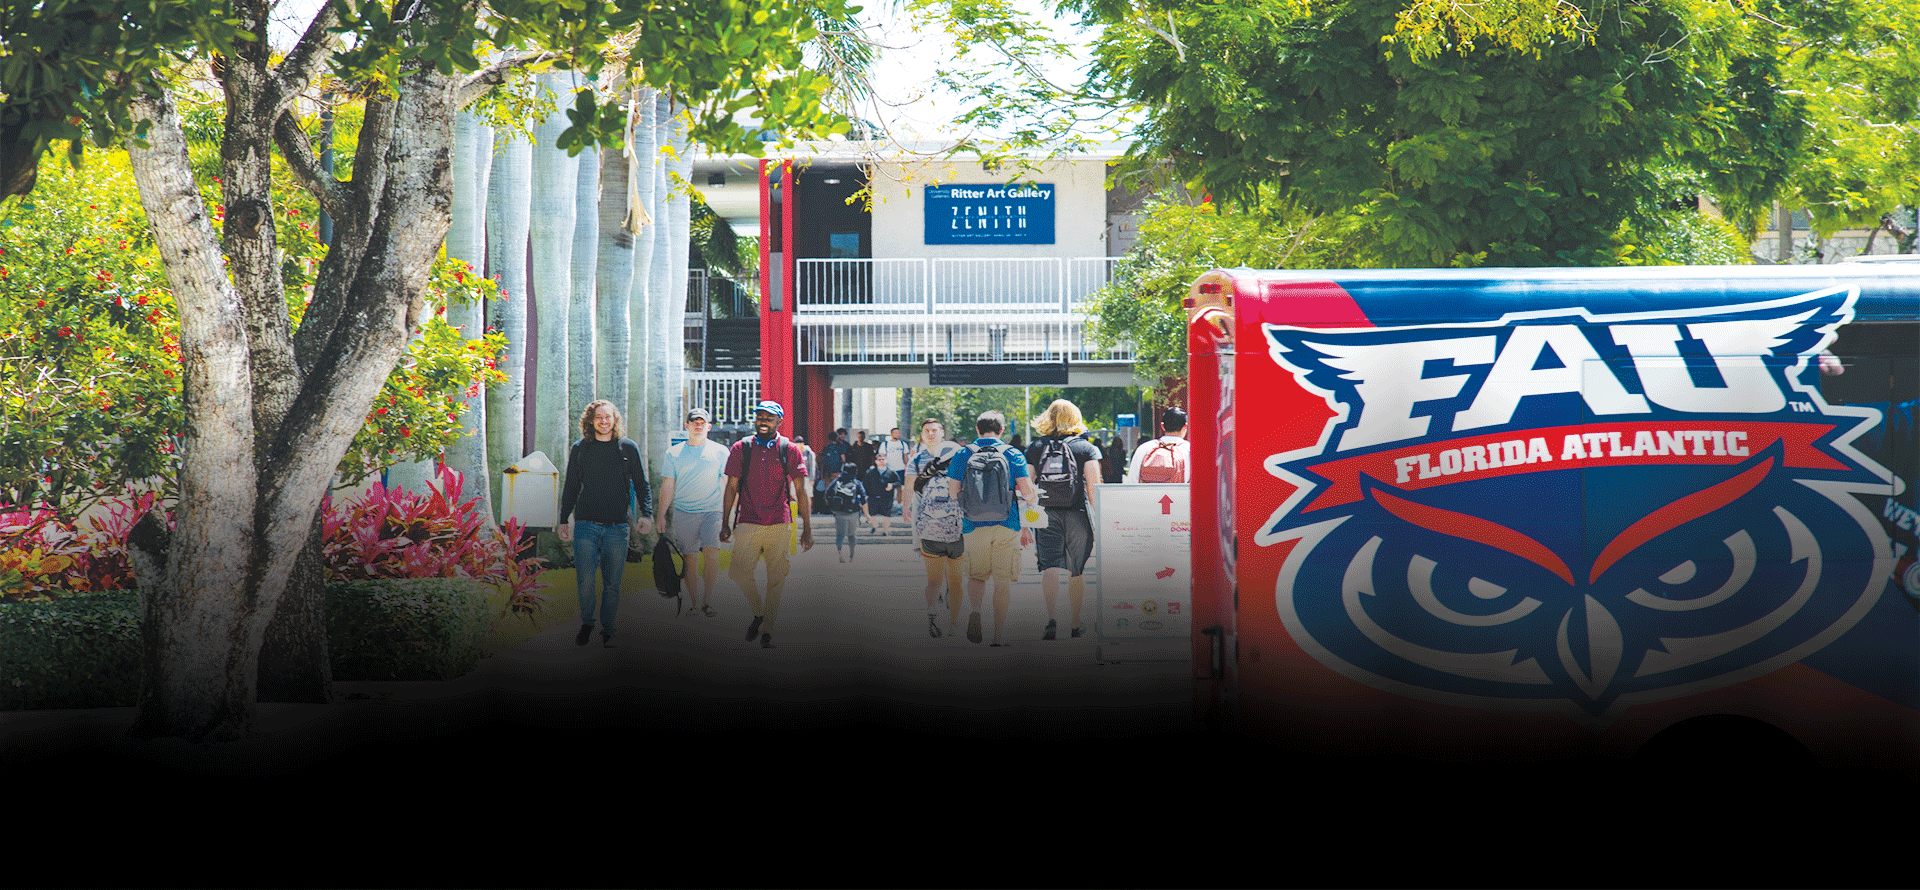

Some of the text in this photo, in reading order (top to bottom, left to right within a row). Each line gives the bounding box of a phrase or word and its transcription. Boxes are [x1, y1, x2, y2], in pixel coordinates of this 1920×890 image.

[951, 188, 1051, 200] Ritter Art Gallery
[1300, 307, 1821, 453] FAU
[1788, 401, 1816, 413] TM
[1394, 431, 1750, 485] FLORIDA ATLANTIC
